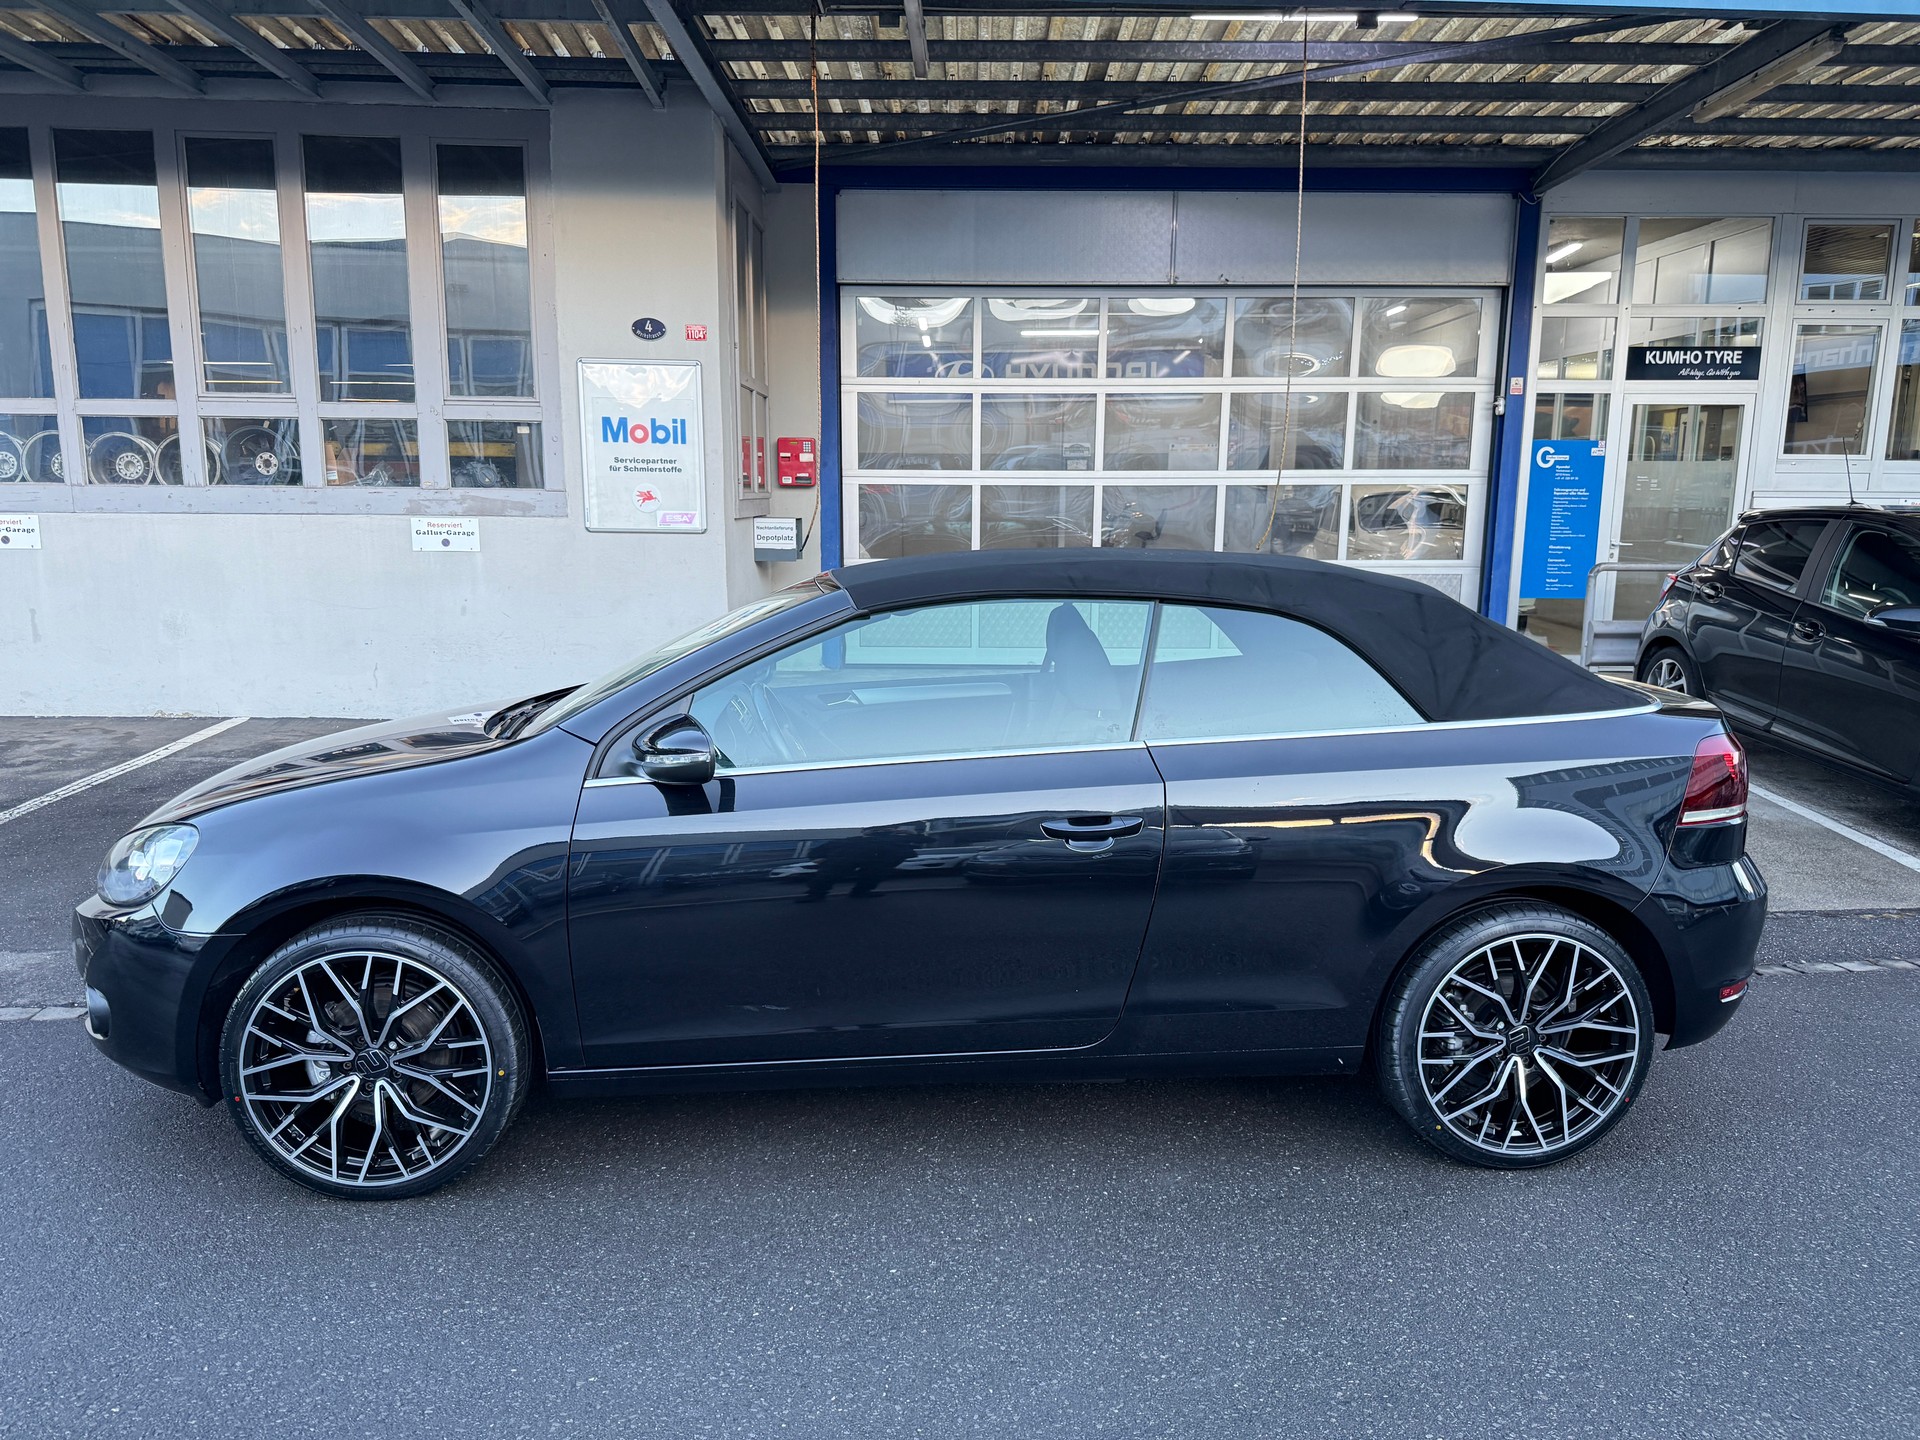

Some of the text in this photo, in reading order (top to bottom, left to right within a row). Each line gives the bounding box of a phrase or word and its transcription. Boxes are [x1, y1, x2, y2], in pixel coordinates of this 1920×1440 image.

[644, 320, 653, 333] 4
[1645, 350, 1743, 365] KUMHO TYRE
[601, 416, 687, 445] Mobil
[613, 457, 677, 466] Servicepartner
[609, 465, 682, 474] für Schmierstoffe
[756, 534, 794, 542] Depotplatz
[426, 953, 454, 973] STAR
